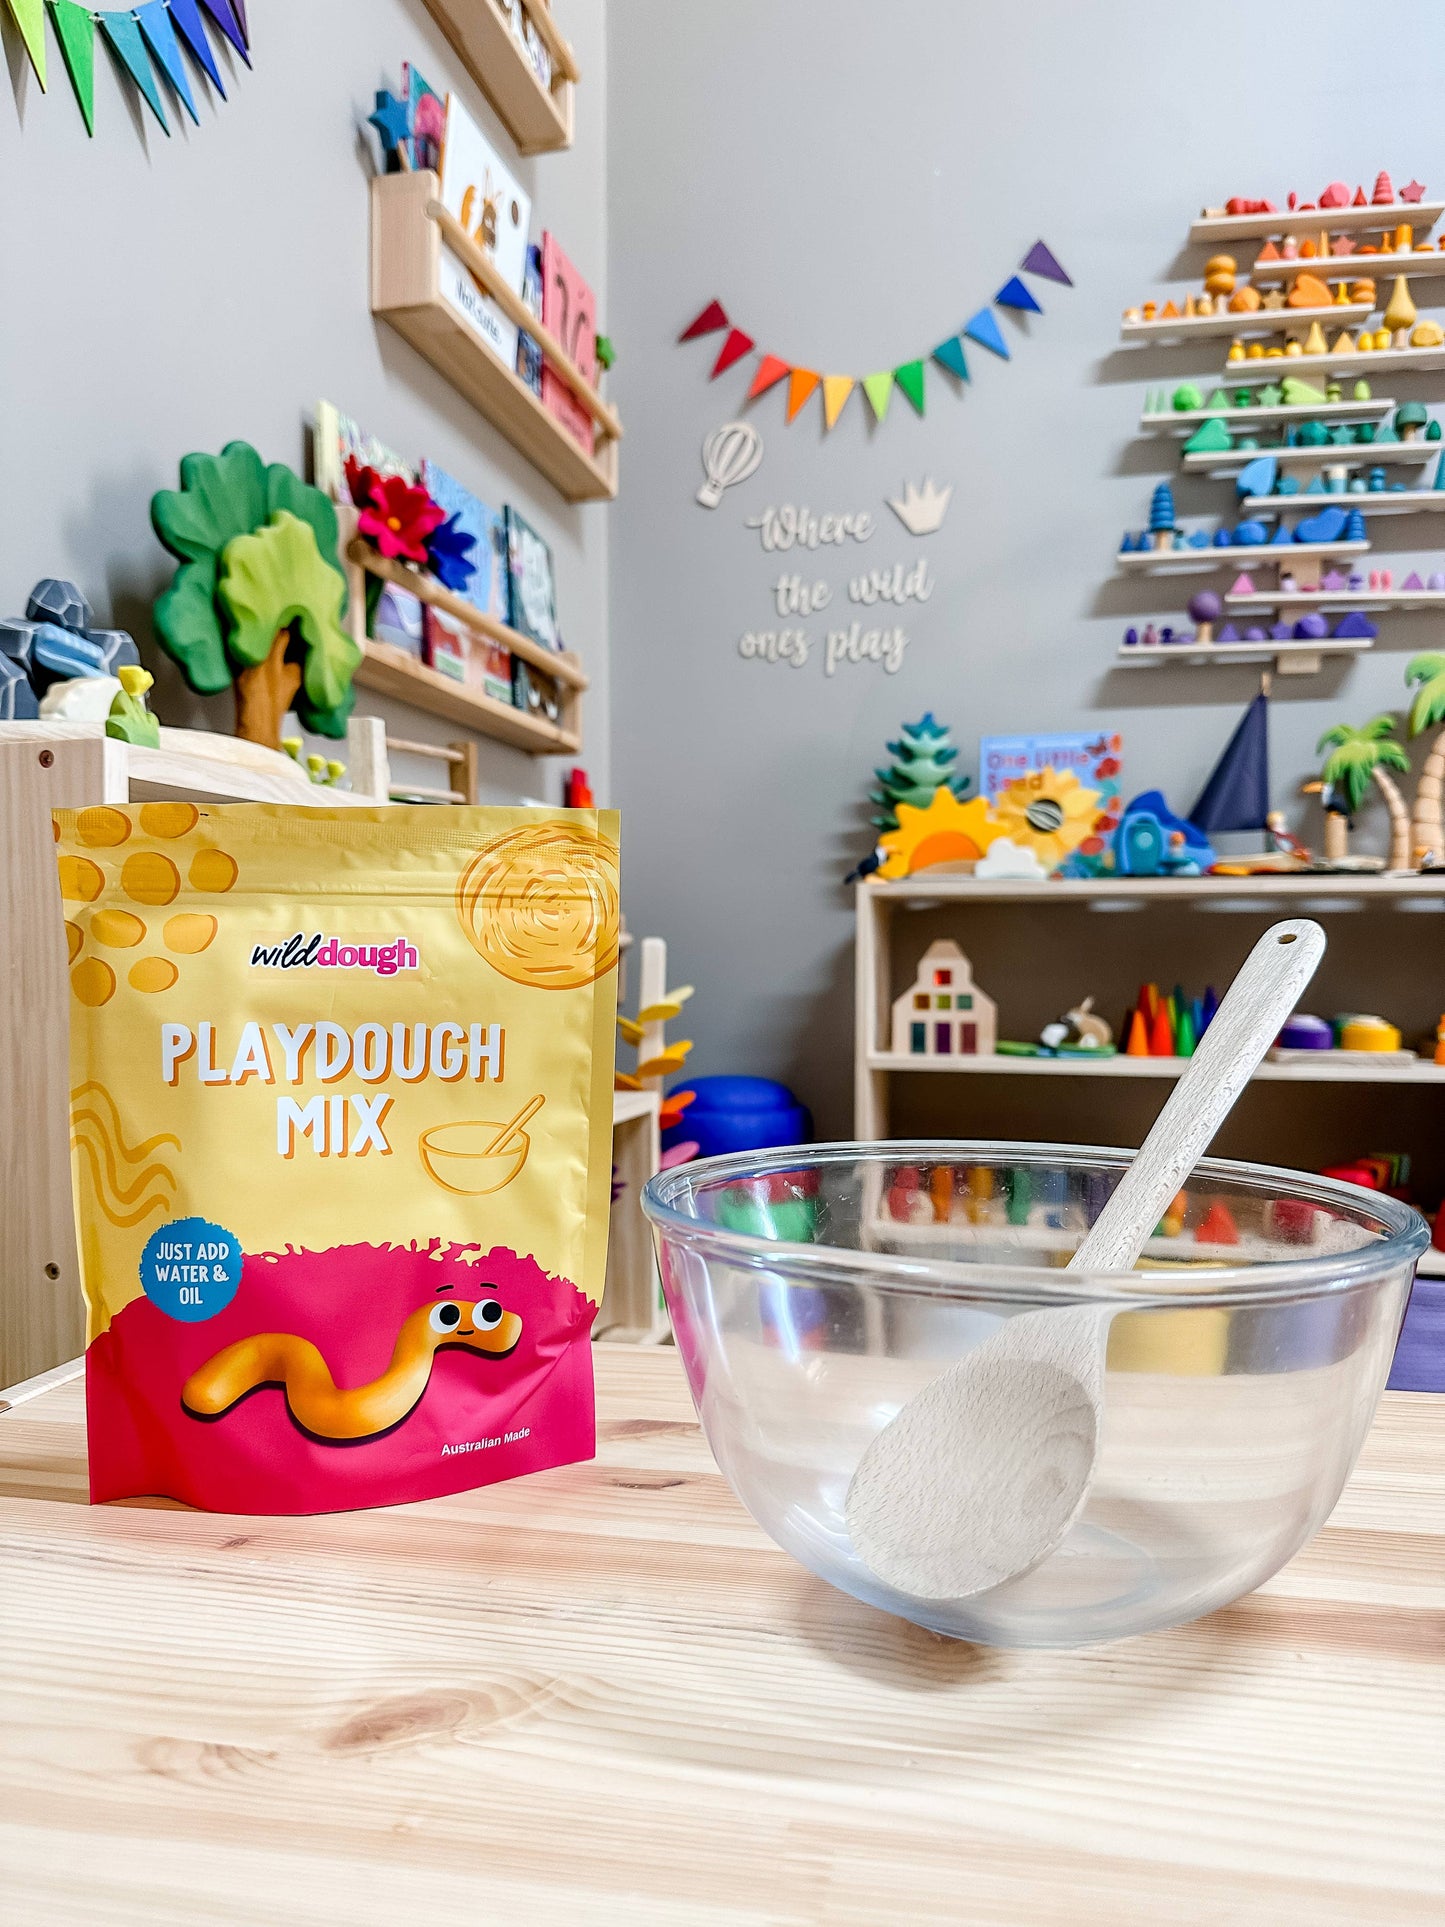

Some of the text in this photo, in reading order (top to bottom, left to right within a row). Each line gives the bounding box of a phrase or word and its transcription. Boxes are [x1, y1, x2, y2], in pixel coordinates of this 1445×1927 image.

[744, 504, 876, 551] Where
[771, 559, 935, 618] the wild
[739, 621, 911, 677] ones play
[988, 750, 1089, 769] One Little
[252, 934, 417, 975] wilddough
[161, 1021, 506, 1086] PLAYDOUGH
[276, 1093, 394, 1159] MIX
[156, 1242, 230, 1261] JUST ADD
[154, 1264, 230, 1283] WATER &
[179, 1286, 204, 1305] OIL
[441, 1427, 531, 1457] Australian Made
